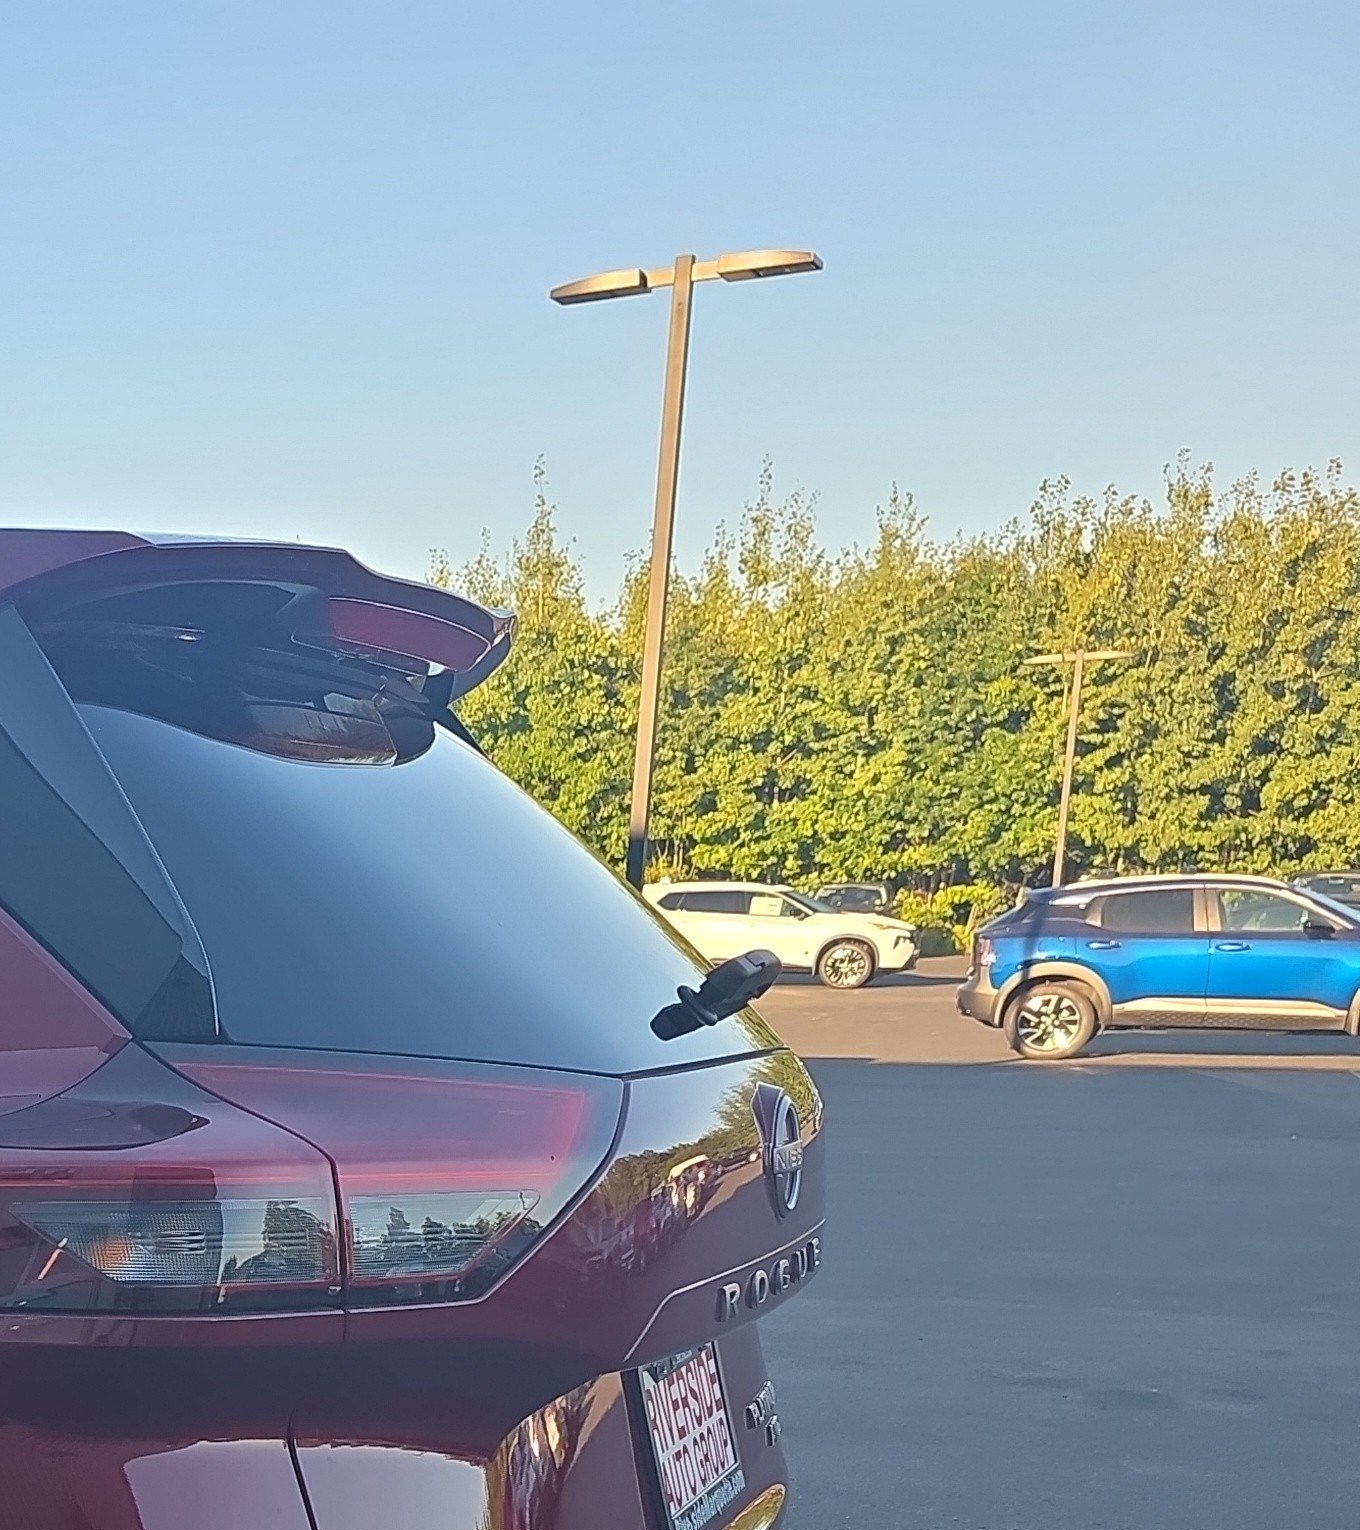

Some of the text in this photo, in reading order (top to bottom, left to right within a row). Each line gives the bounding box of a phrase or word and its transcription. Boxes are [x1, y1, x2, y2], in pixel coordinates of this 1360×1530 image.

[716, 1237, 821, 1323] ROGUE
[646, 1350, 724, 1453] RIVERSIDE
[661, 1446, 698, 1511] AUTO
[692, 1416, 736, 1486] GROUP
